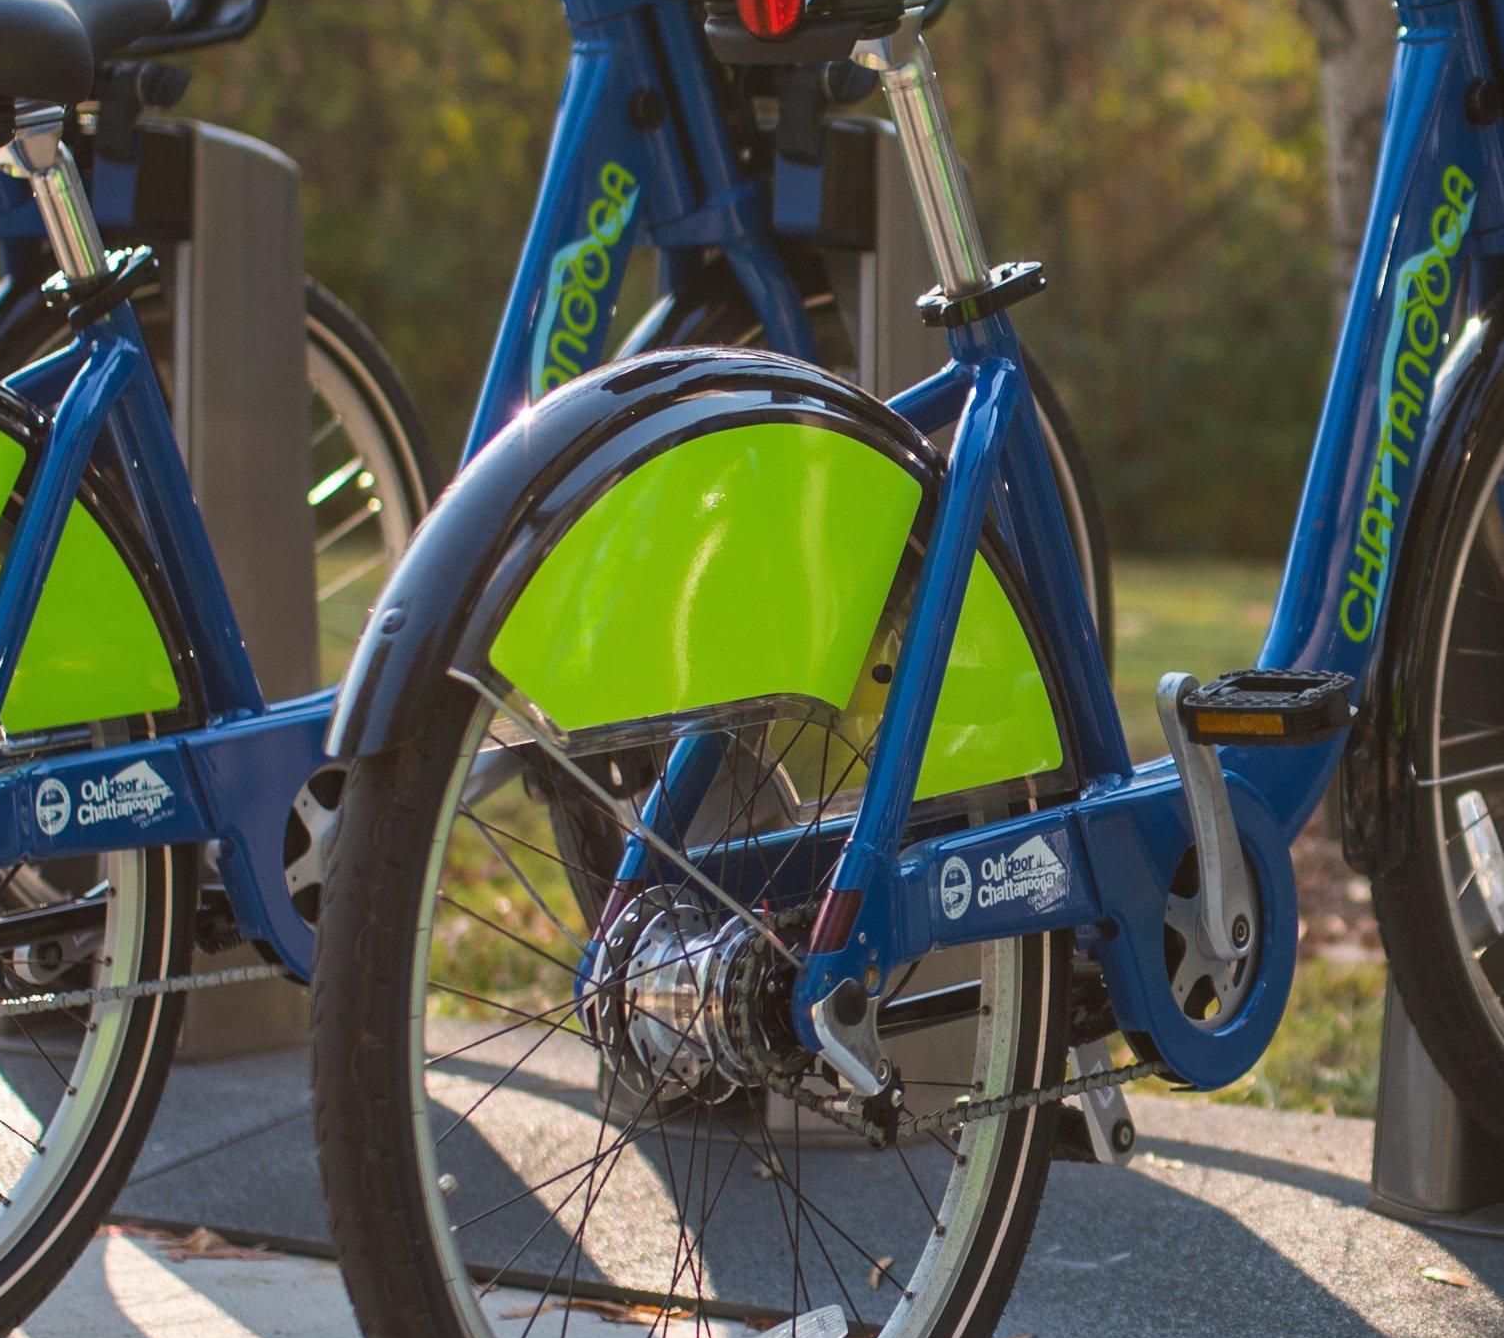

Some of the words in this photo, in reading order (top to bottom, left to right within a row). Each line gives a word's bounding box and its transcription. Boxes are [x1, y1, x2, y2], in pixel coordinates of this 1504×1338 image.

[1339, 164, 1475, 643] CHATTANOOGA
[81, 775, 140, 802] Outdoor
[77, 793, 163, 826] Chattanooga
[981, 853, 1035, 882] Outdoor
[977, 873, 1055, 909] Chattanooga
